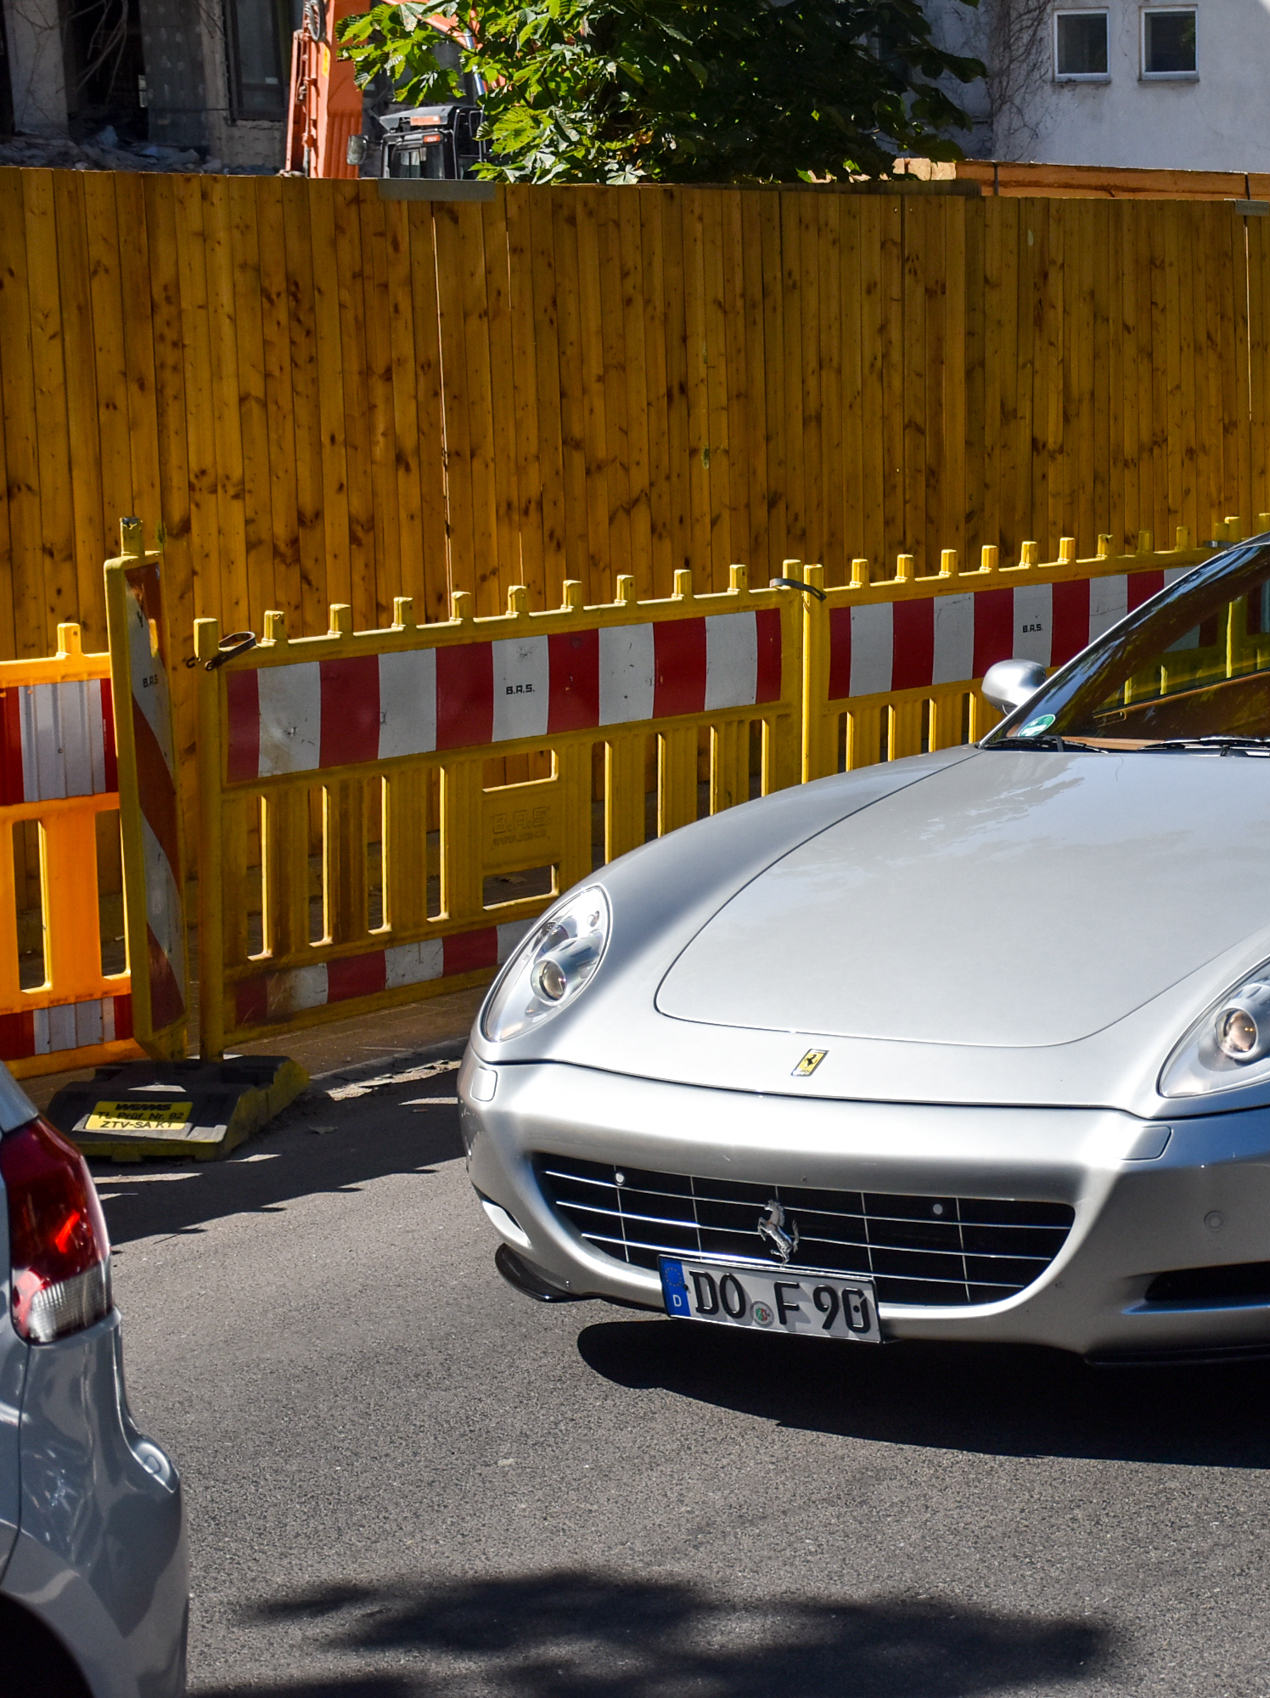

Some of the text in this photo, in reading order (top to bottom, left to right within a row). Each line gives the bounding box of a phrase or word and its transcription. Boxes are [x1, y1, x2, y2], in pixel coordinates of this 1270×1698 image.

[1022, 623, 1044, 633] B.A.S.
[506, 683, 535, 695] B.A.S.
[100, 1120, 152, 1129] ZTV-SA
[672, 1294, 682, 1307] D
[689, 1269, 871, 1334] DO F 90
